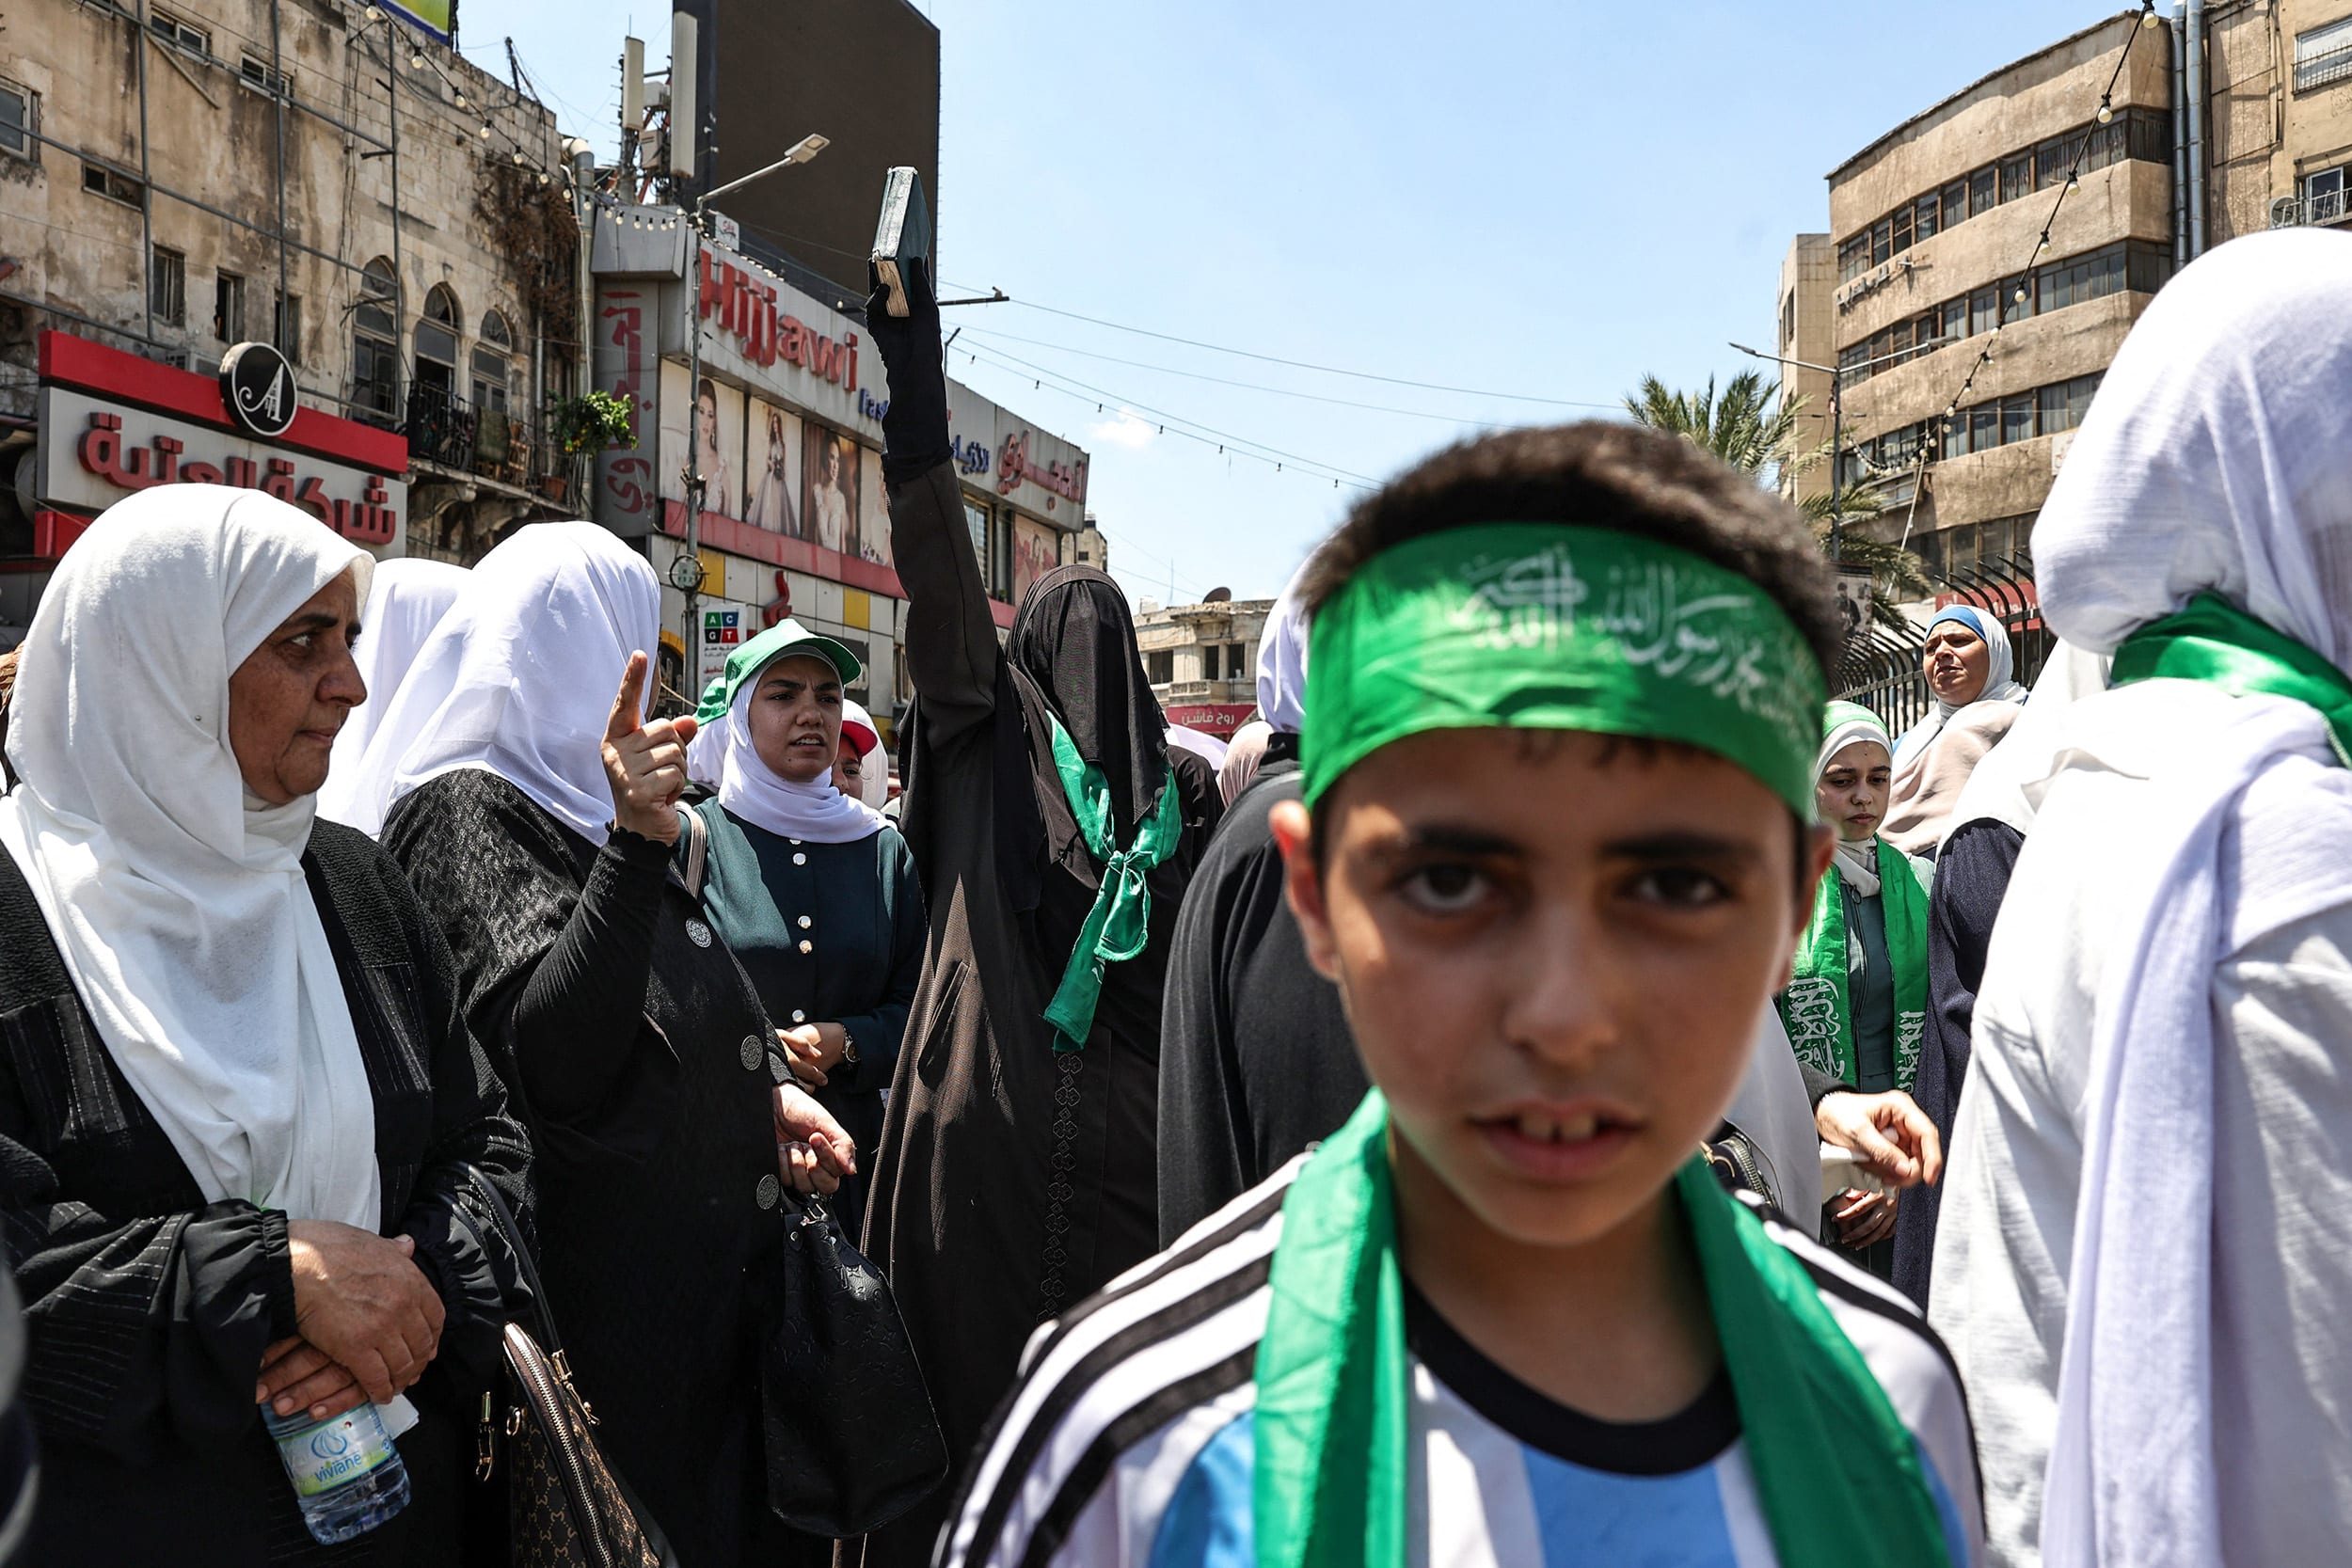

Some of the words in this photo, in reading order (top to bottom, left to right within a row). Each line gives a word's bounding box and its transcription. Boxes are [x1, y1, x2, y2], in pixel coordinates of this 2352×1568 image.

[699, 248, 858, 391] Hijjawi
[1181, 710, 1214, 725] فاشن
[1216, 712, 1235, 724] روح
[314, 1454, 361, 1482] viviane
